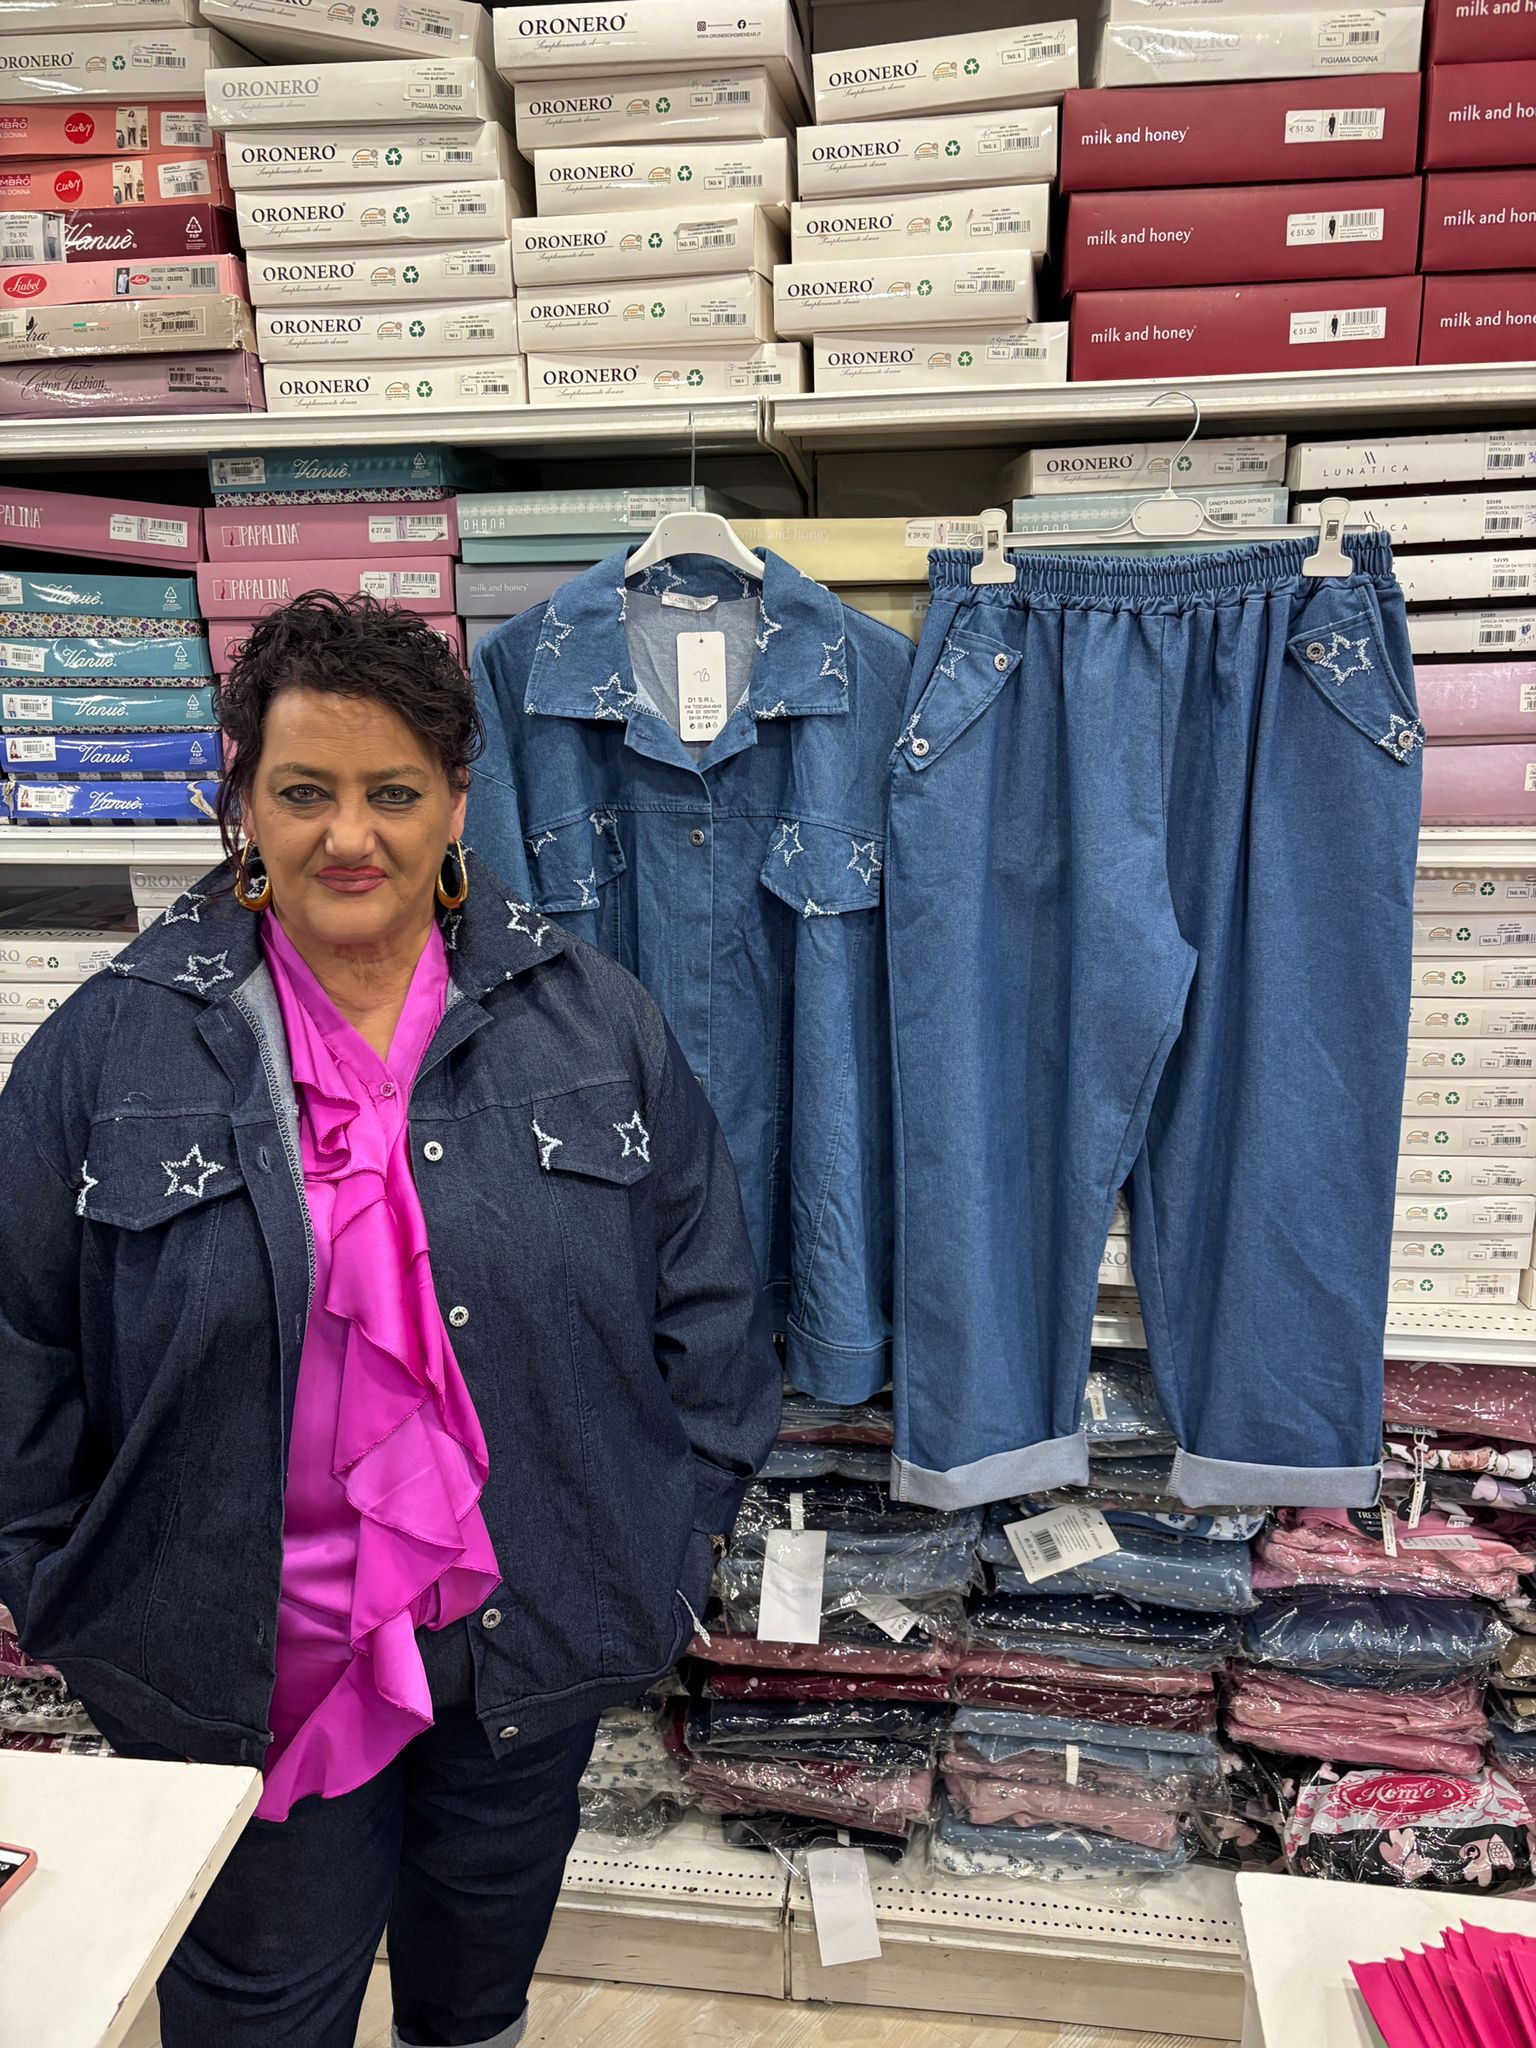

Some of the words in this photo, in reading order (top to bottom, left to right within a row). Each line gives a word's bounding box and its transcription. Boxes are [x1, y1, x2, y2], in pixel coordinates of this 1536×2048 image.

[1456, 0, 1489, 18] milk
[1493, 0, 1520, 15] and
[518, 14, 626, 37] ORONERO
[0, 53, 72, 70] ORONERO
[1320, 56, 1351, 64] PIGIAMA
[828, 62, 917, 87] ORONERO
[222, 79, 319, 98] ORONERO
[411, 101, 439, 110] PIGIAMA
[439, 103, 463, 111] DONNA
[529, 96, 613, 116] ORONERO
[1448, 104, 1481, 122] milk
[1485, 102, 1512, 120] and
[1082, 128, 1112, 146] milk
[1115, 127, 1141, 144] and
[1144, 126, 1187, 147] honey
[241, 145, 336, 163] ORONERO
[812, 140, 900, 161] ORONERO
[550, 164, 634, 182] ORONERO
[251, 204, 344, 223] ORONERO
[1444, 209, 1475, 226] milk
[1479, 208, 1506, 224] and
[806, 215, 892, 235] ORONERO
[65, 222, 134, 250] Vanuè
[525, 232, 606, 250] ORONERO
[1086, 228, 1117, 246] milk
[1120, 227, 1146, 244] and
[1149, 226, 1192, 248] honey
[263, 264, 354, 282] ORONERO
[8, 276, 40, 294] Liabel
[787, 279, 873, 298] ORONERO
[530, 302, 610, 319] ORONERO
[1440, 312, 1471, 328] milk
[1476, 310, 1501, 326] and
[270, 318, 361, 335] ORONERO
[1090, 327, 1121, 344] milk
[1124, 326, 1149, 342] and
[1153, 324, 1195, 345] honey
[828, 349, 914, 367] ORONERO
[543, 368, 637, 386] ORONERO
[279, 378, 369, 396] ORONERO
[292, 458, 349, 479] Vanuè
[1046, 455, 1132, 473] ORONERO
[1324, 464, 1409, 477] LUNATICA
[240, 524, 300, 546] PAPALINA
[231, 578, 290, 600] PAPALINA
[470, 584, 487, 592] milk
[488, 583, 502, 592] and
[504, 583, 528, 593] honey
[63, 647, 115, 668] Vanuè
[75, 700, 127, 717] Vanuè
[79, 745, 131, 764] Vanuè
[89, 792, 141, 810] Vanuè
